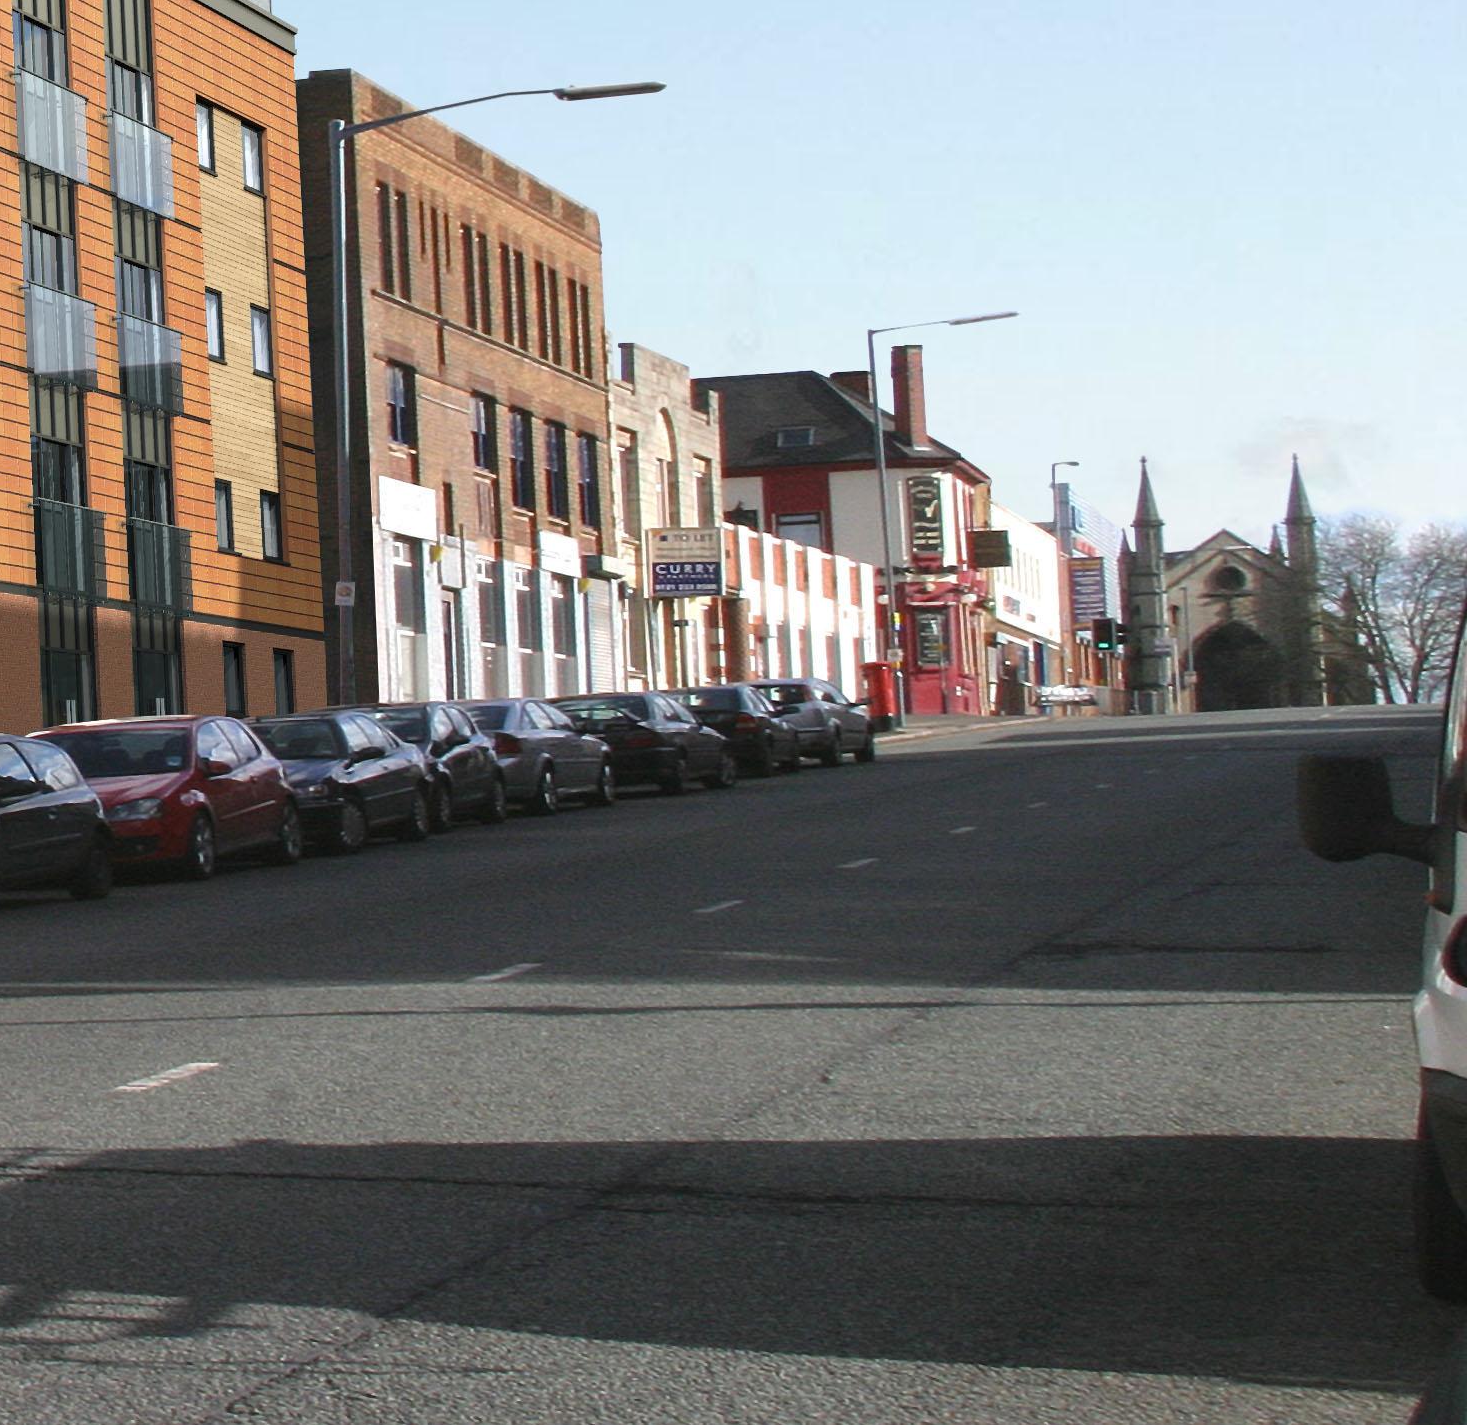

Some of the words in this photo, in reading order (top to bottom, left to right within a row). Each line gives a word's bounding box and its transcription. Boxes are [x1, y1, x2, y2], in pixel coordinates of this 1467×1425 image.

[673, 533, 689, 543] TO
[694, 533, 713, 543] LET
[655, 564, 716, 574] CURRY
